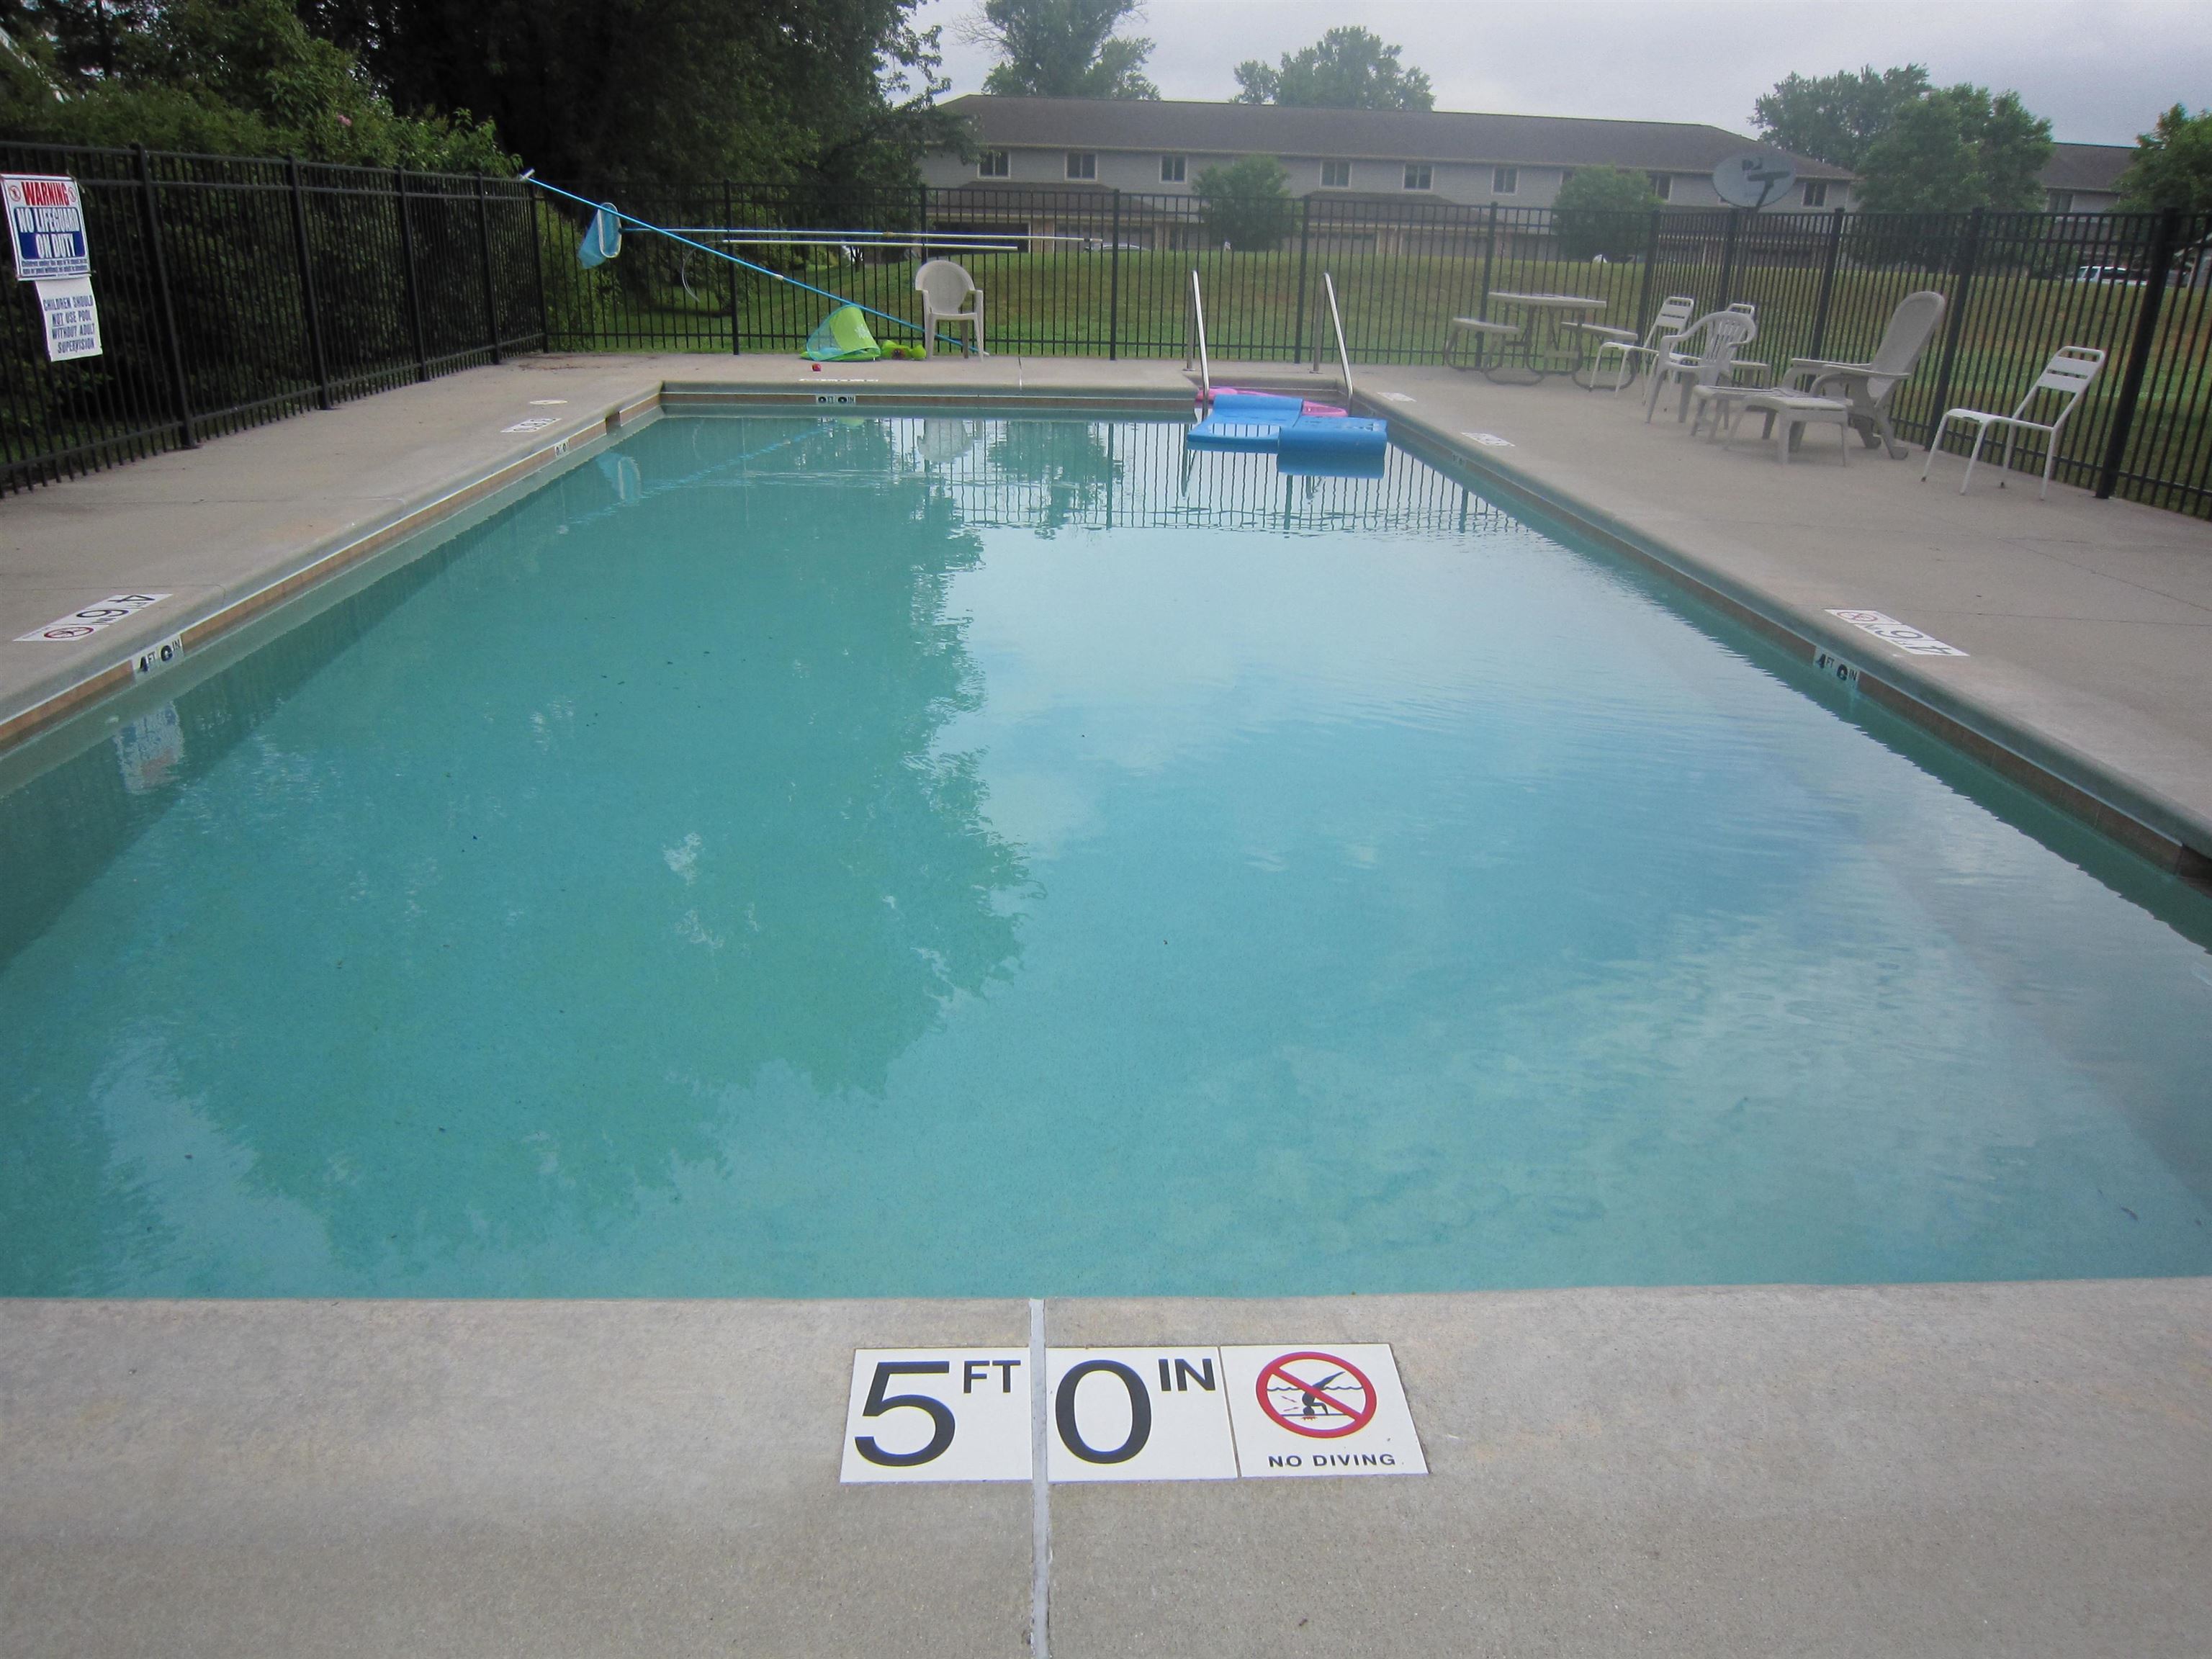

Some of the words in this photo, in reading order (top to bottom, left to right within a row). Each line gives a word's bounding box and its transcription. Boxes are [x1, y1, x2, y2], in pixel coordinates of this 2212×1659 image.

[21, 181, 70, 206] WARNING
[16, 207, 35, 233] NO
[34, 207, 80, 233] LIFEGUARD
[35, 233, 53, 258] ON
[51, 233, 76, 258] DUTY
[43, 297, 71, 311] CHILDREN
[73, 295, 94, 307] SHOULD
[52, 312, 63, 326] NOT
[66, 310, 77, 323] USE
[78, 309, 92, 322] POOL
[52, 325, 77, 340] WITHOUT
[79, 323, 95, 336] ADULT
[58, 337, 95, 354] SUPERVISION
[1268, 1455, 1302, 1467] NO
[1313, 1454, 1395, 1467] DIVING
